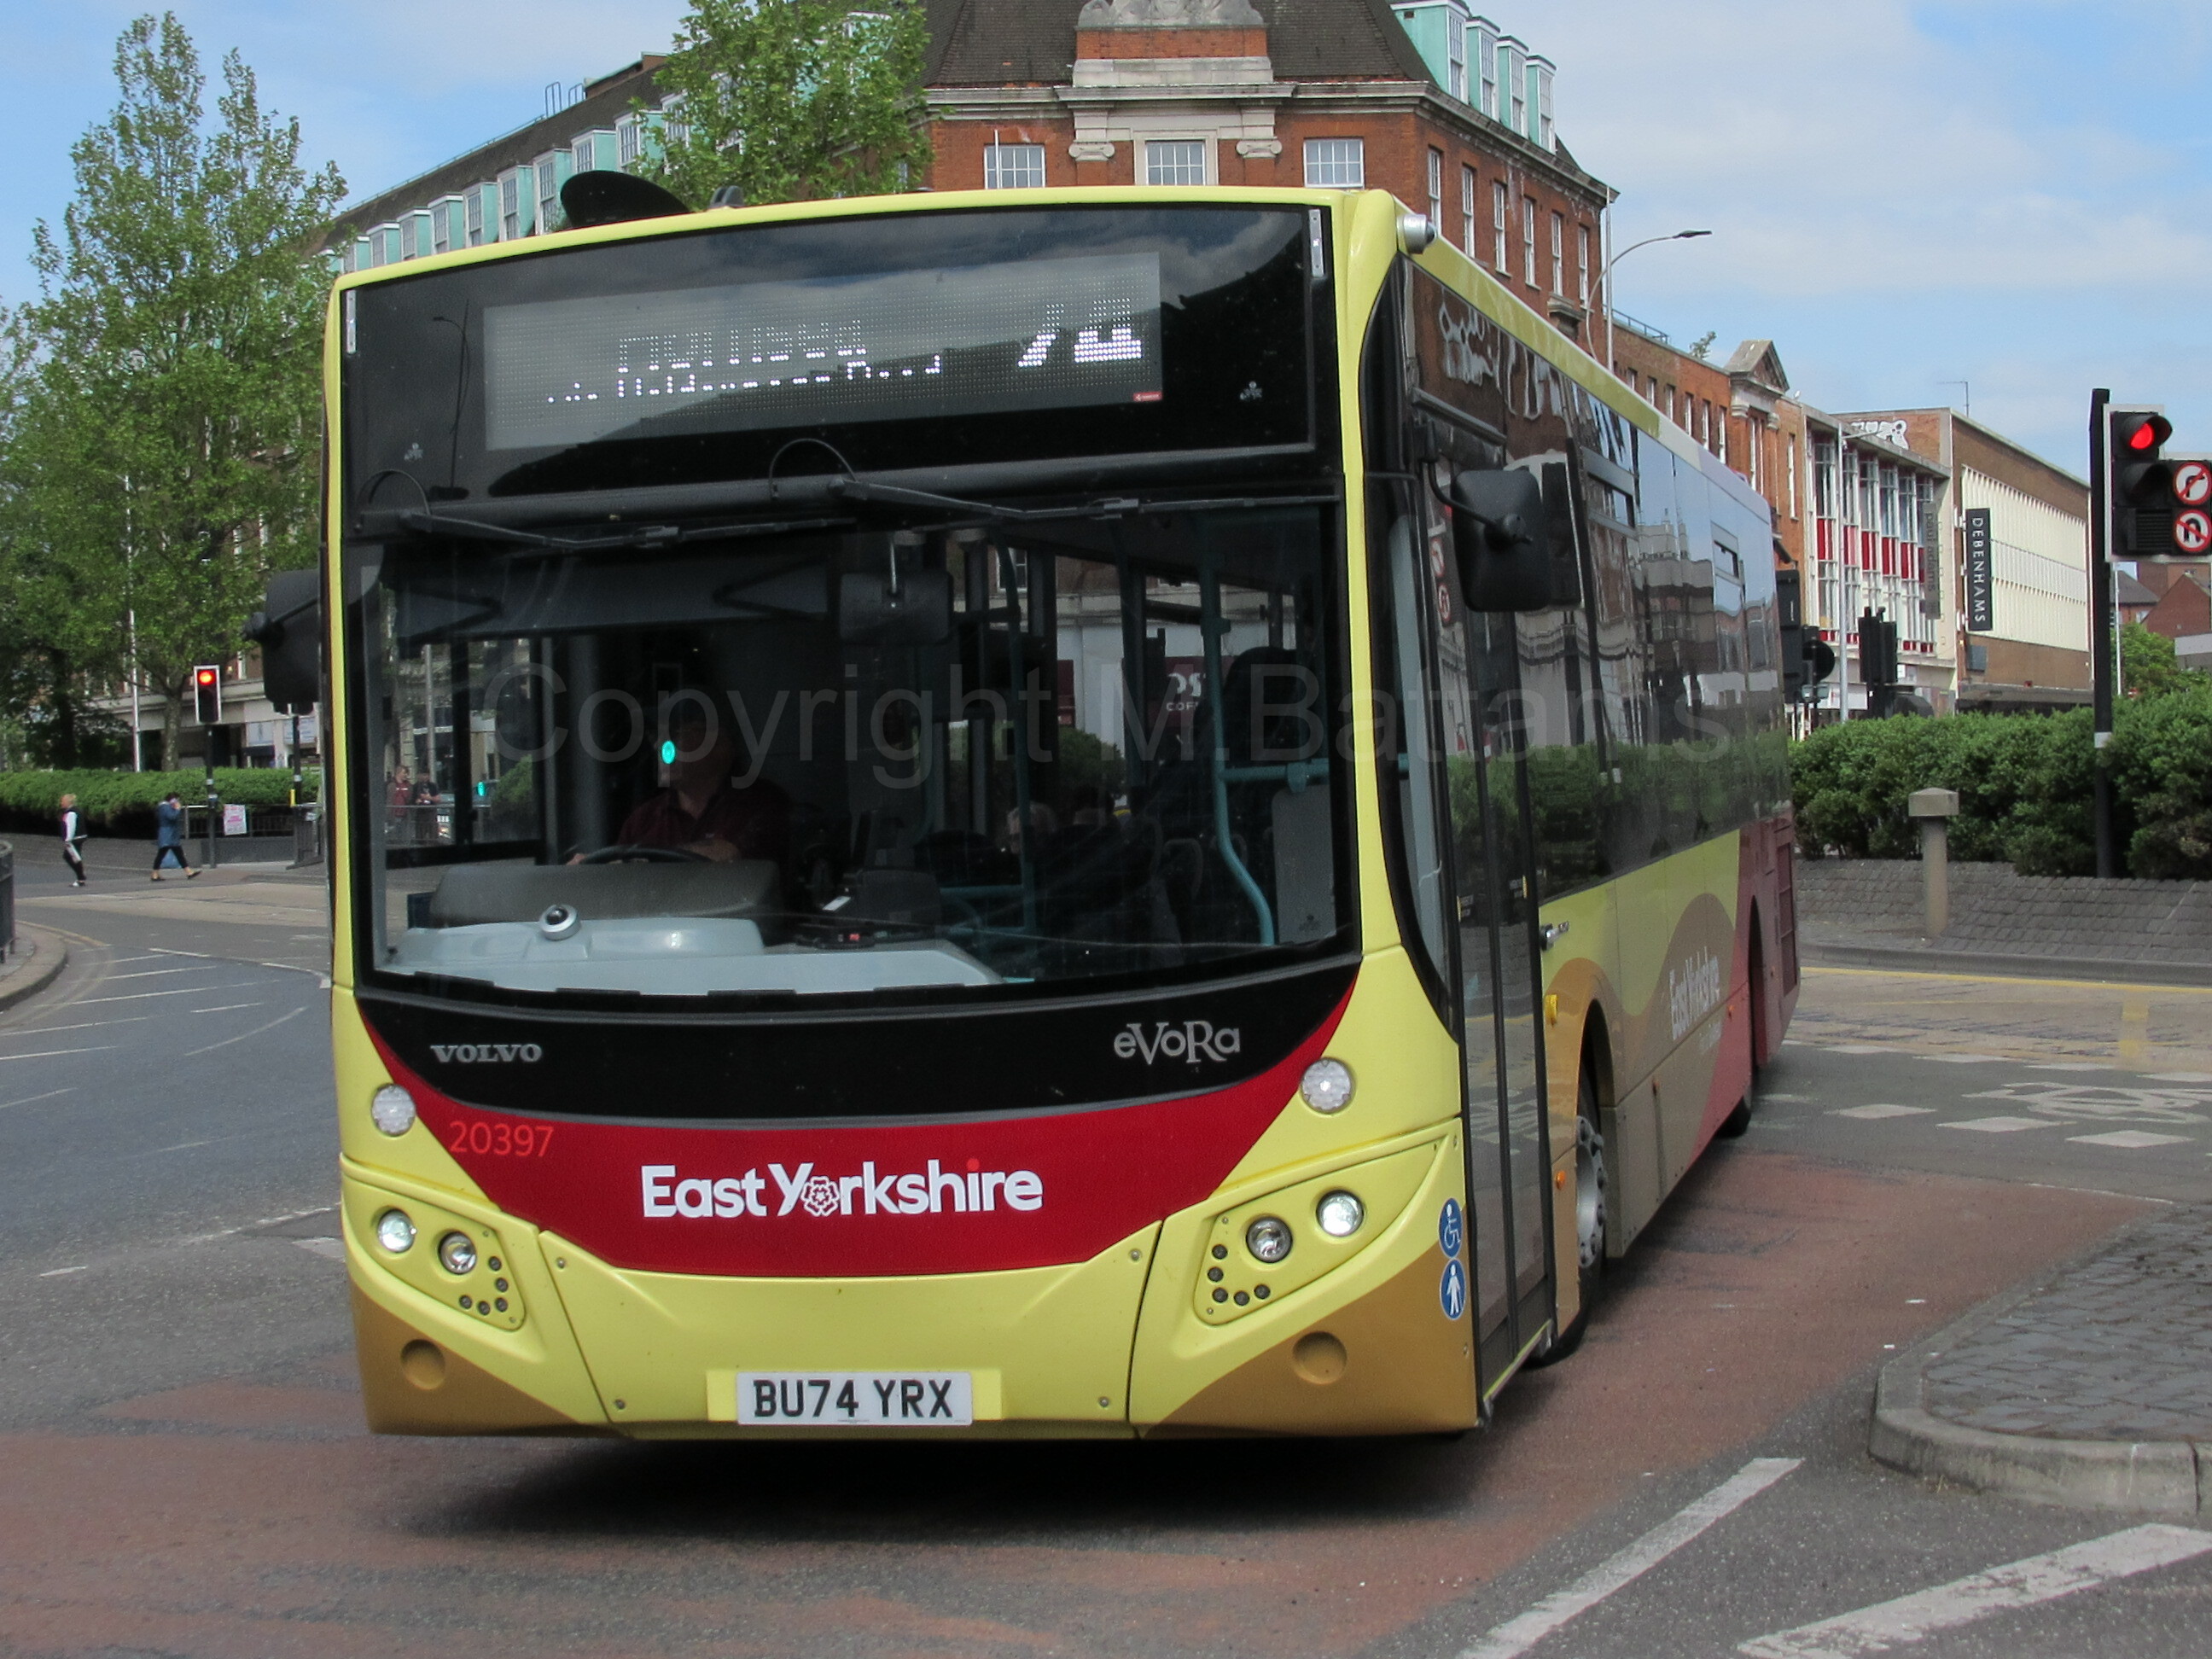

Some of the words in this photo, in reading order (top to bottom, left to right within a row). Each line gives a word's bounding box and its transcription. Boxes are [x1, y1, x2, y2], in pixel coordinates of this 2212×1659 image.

[1971, 517, 1986, 622] DEBENHAMS
[429, 1043, 543, 1062] VOLVO
[449, 1121, 555, 1157] 20397
[641, 1164, 767, 1219] East
[767, 1157, 1044, 1217] Yorkshire
[753, 1379, 859, 1417] BU74
[873, 1379, 953, 1417] YRX
